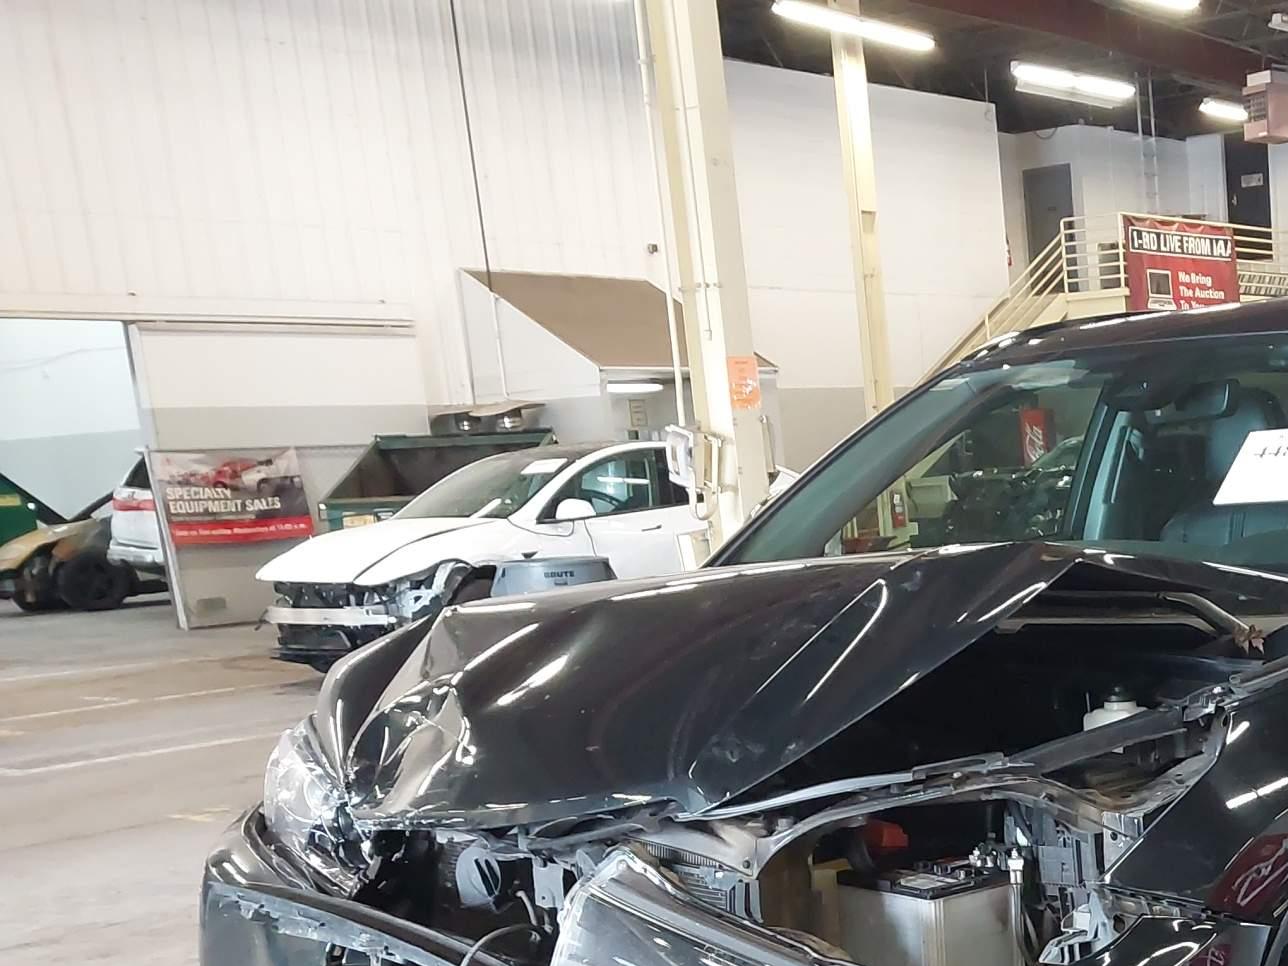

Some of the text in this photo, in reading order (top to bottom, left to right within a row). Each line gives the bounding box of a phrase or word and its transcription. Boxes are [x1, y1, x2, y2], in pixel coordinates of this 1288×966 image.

[1160, 233, 1182, 253] LIVE
[1183, 236, 1212, 256] FROM
[1178, 271, 1212, 288] We Bring
[1179, 285, 1225, 300] The Auction
[166, 487, 232, 500] SPECIALTY
[168, 497, 281, 514] EQUIPMENT SALES
